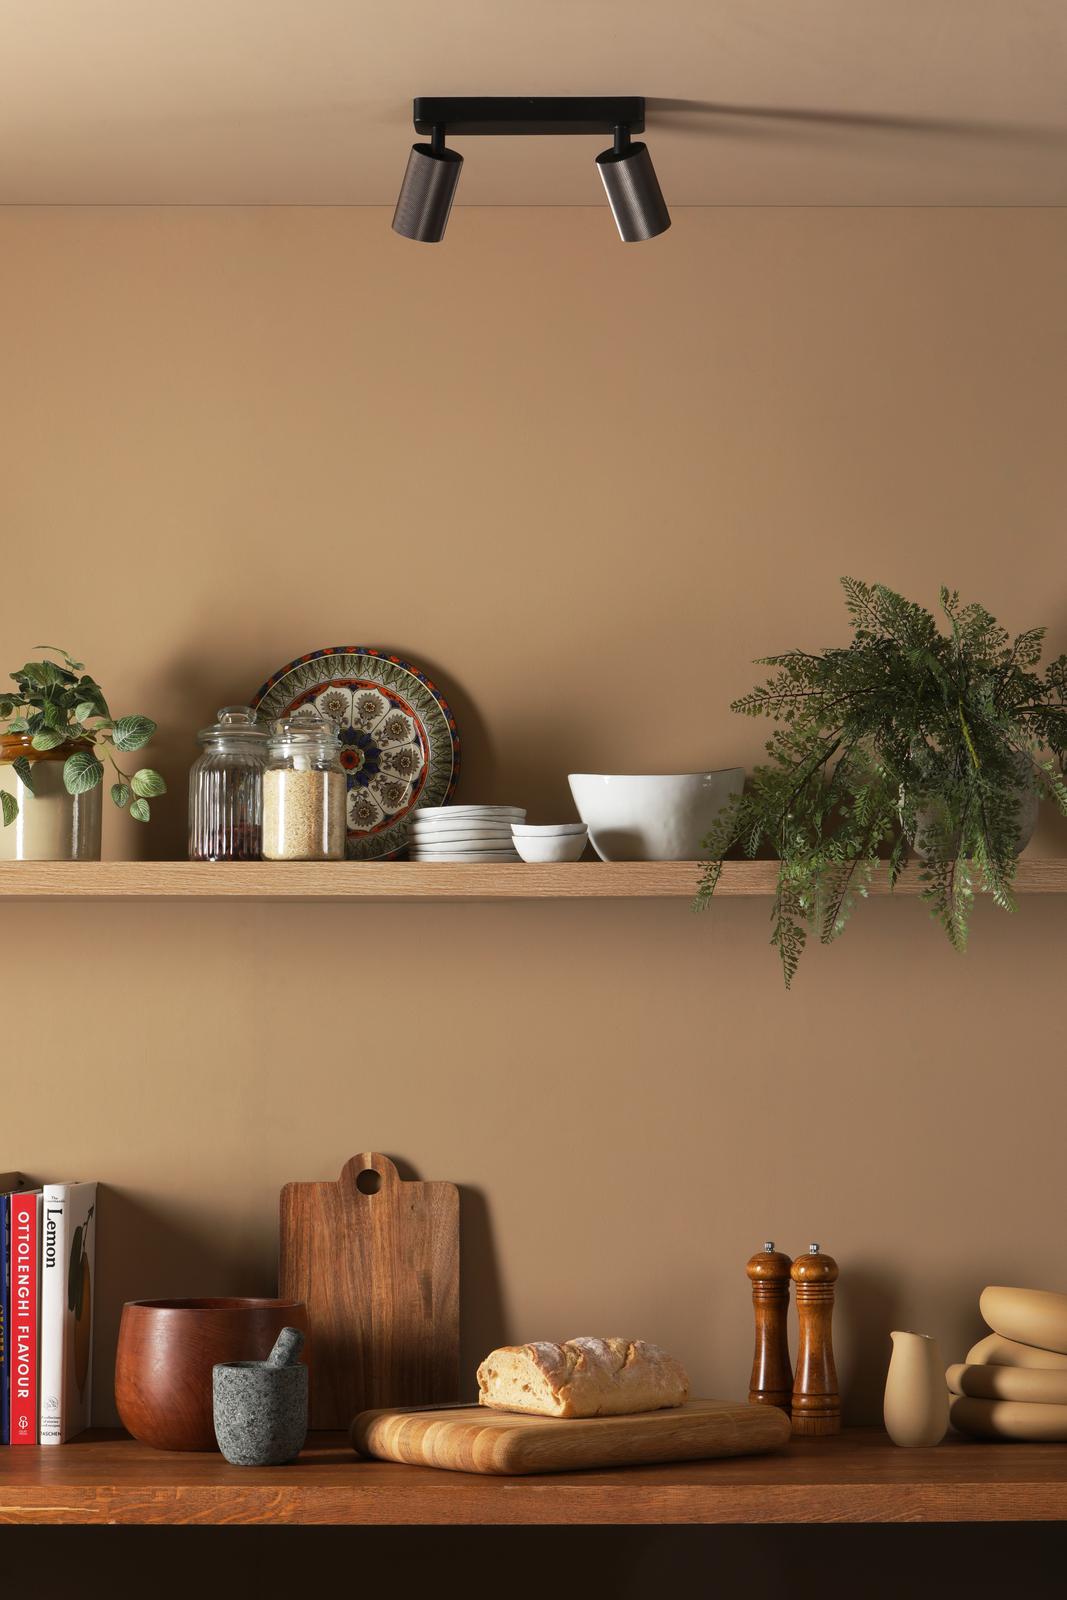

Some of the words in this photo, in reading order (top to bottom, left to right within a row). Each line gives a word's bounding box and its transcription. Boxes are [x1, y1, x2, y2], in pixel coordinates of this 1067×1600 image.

[18, 1211, 30, 1316] OTTOLENGHI
[46, 1208, 63, 1268] Lemon
[18, 1326, 30, 1398] FLAVOUR
